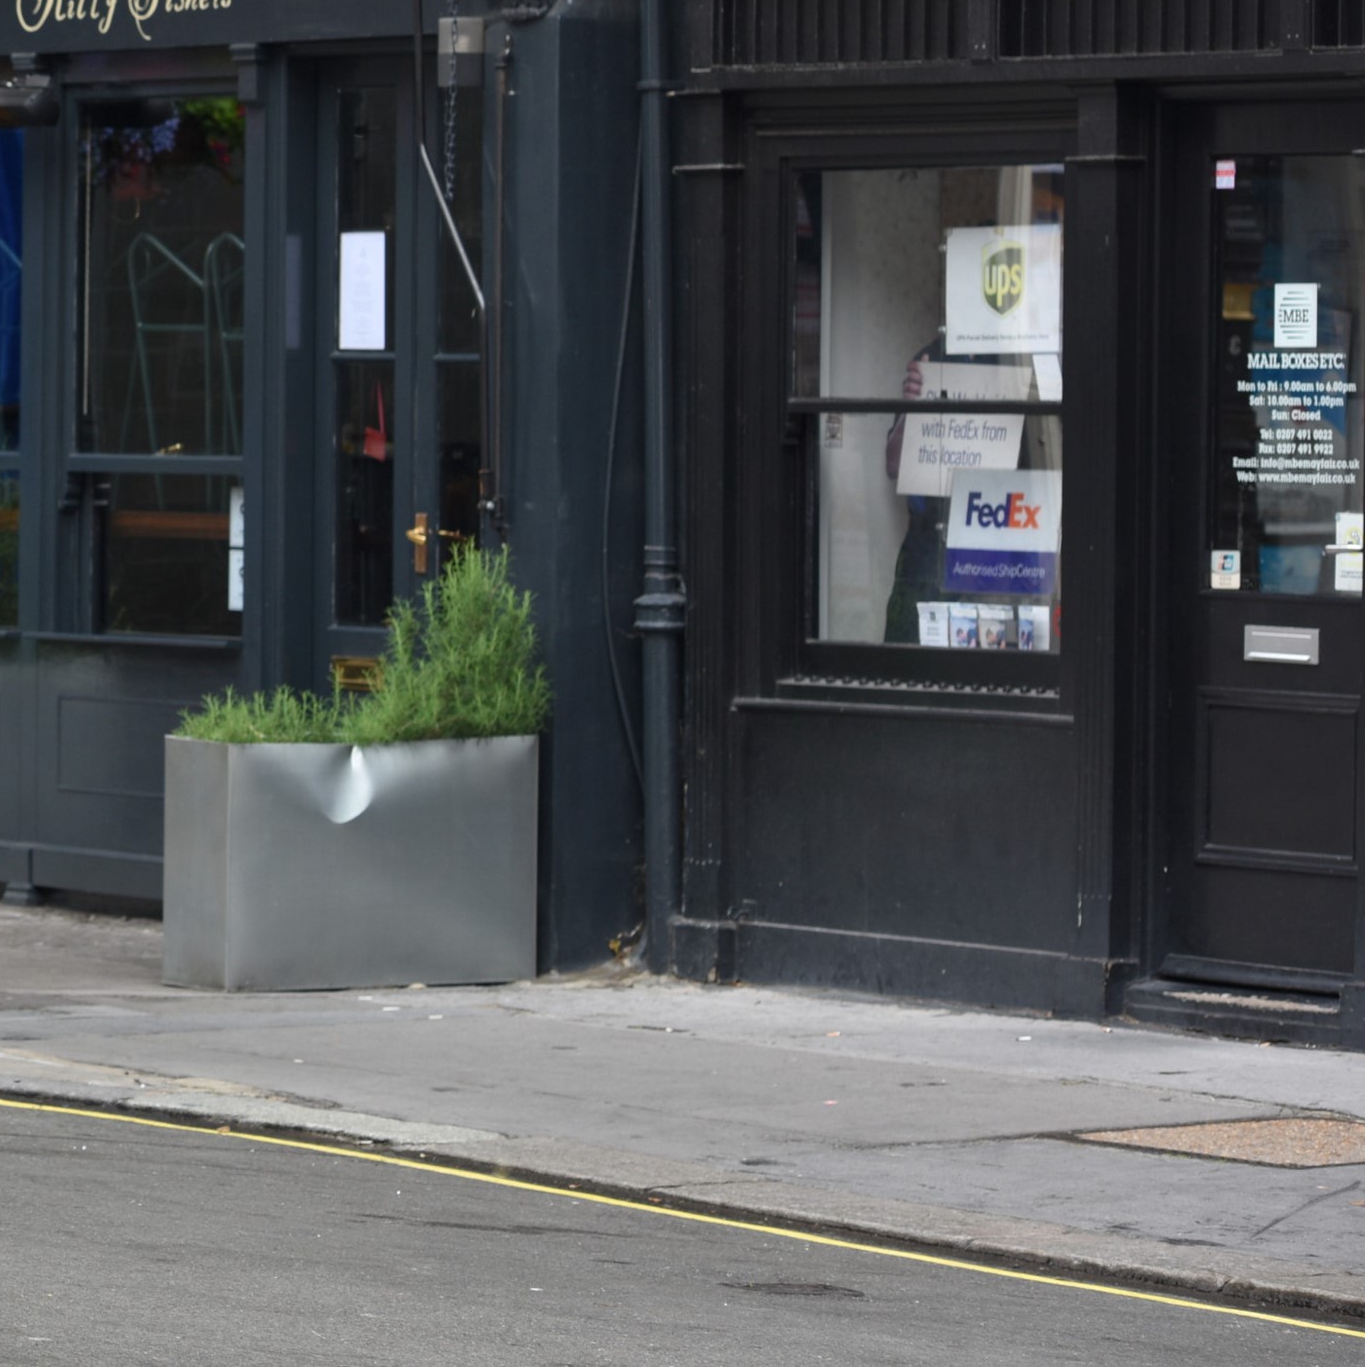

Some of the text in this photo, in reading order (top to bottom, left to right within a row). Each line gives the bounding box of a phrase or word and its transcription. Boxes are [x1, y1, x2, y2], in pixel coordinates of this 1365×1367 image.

[983, 264, 1023, 307] ups
[1283, 308, 1309, 323] MBE
[1247, 353, 1281, 369] MAIL
[1281, 353, 1319, 369] BOXES
[1237, 381, 1255, 392] Mon
[1257, 381, 1265, 392] to
[1267, 381, 1278, 392] Fri
[1284, 381, 1315, 392] 9.00am
[1316, 381, 1325, 392] to
[1249, 395, 1344, 409] Sat: 10.00am to 1.00pm
[1271, 409, 1321, 421] Sun: Closed
[922, 420, 1007, 441] with FedEx from
[1260, 429, 1275, 440] Tel:
[1276, 429, 1296, 440] 0207
[1297, 429, 1311, 440] 491
[1259, 443, 1276, 454] Fax:
[1277, 443, 1297, 454] 0207
[1297, 443, 1312, 454] 491
[918, 447, 982, 466] this location
[1233, 457, 1260, 469] Email:
[1236, 471, 1257, 482] Web:
[965, 491, 1041, 529] FedEx
